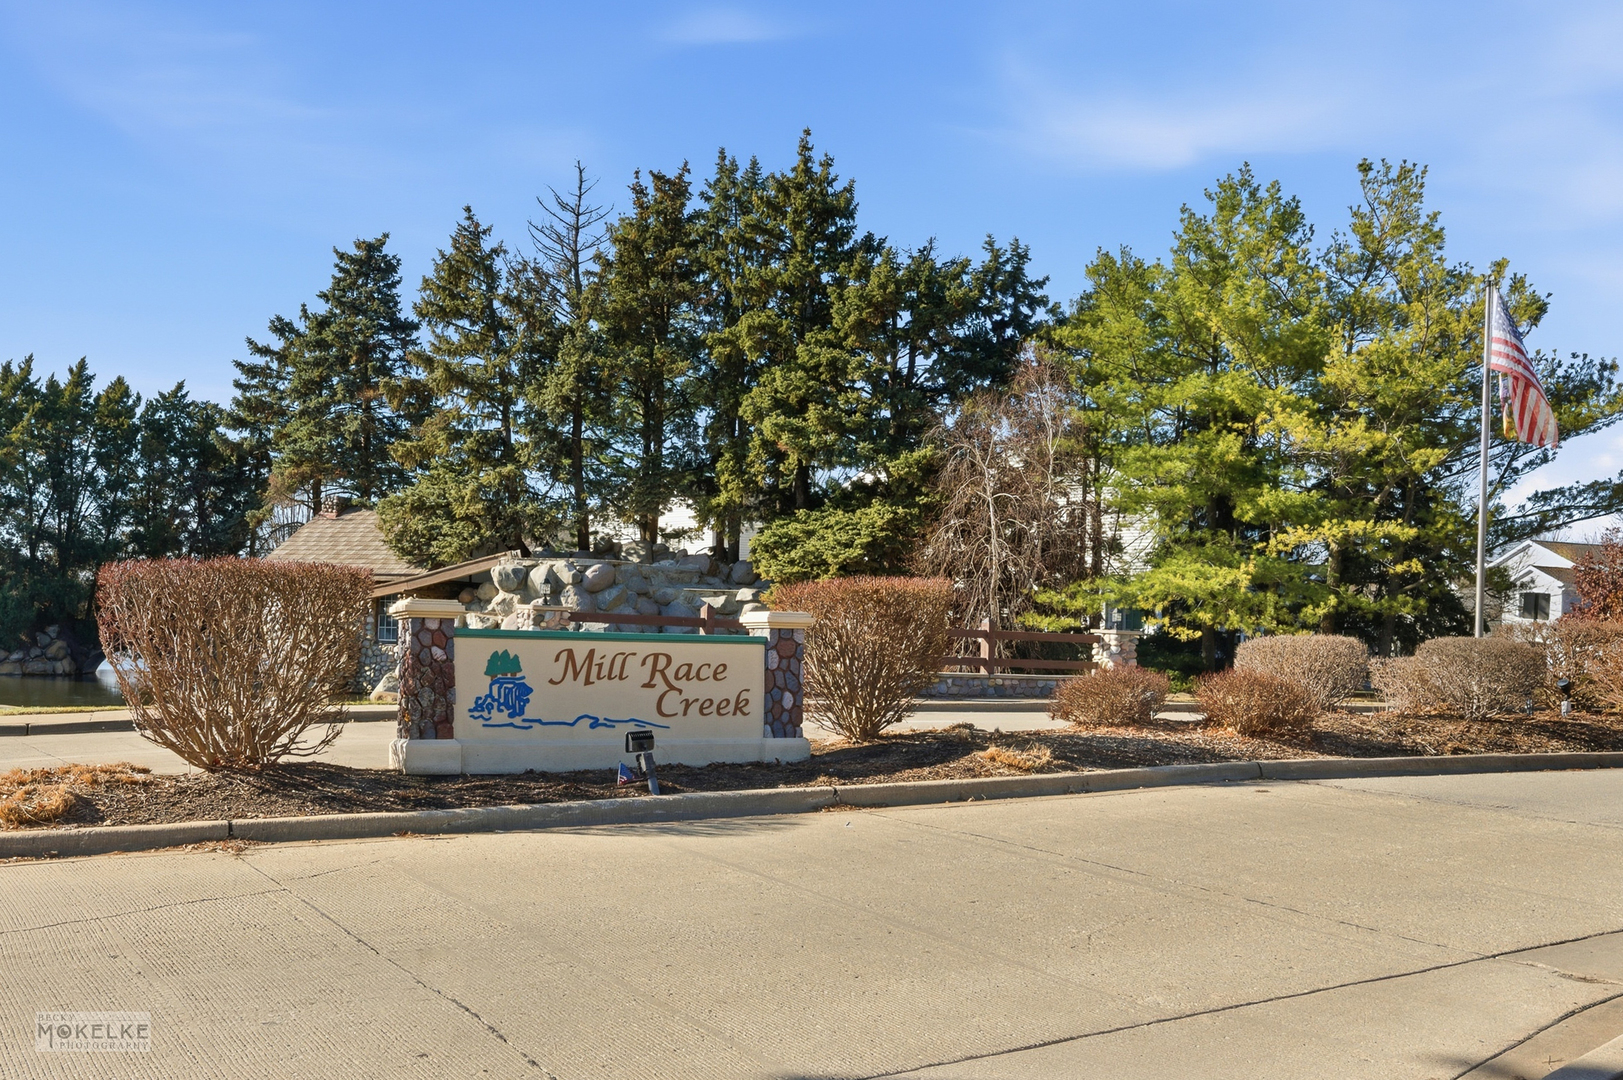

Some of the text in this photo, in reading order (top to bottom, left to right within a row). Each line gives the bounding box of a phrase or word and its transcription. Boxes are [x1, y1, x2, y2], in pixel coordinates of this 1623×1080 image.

[548, 648, 728, 691] Mill Race
[655, 688, 751, 718] Creek
